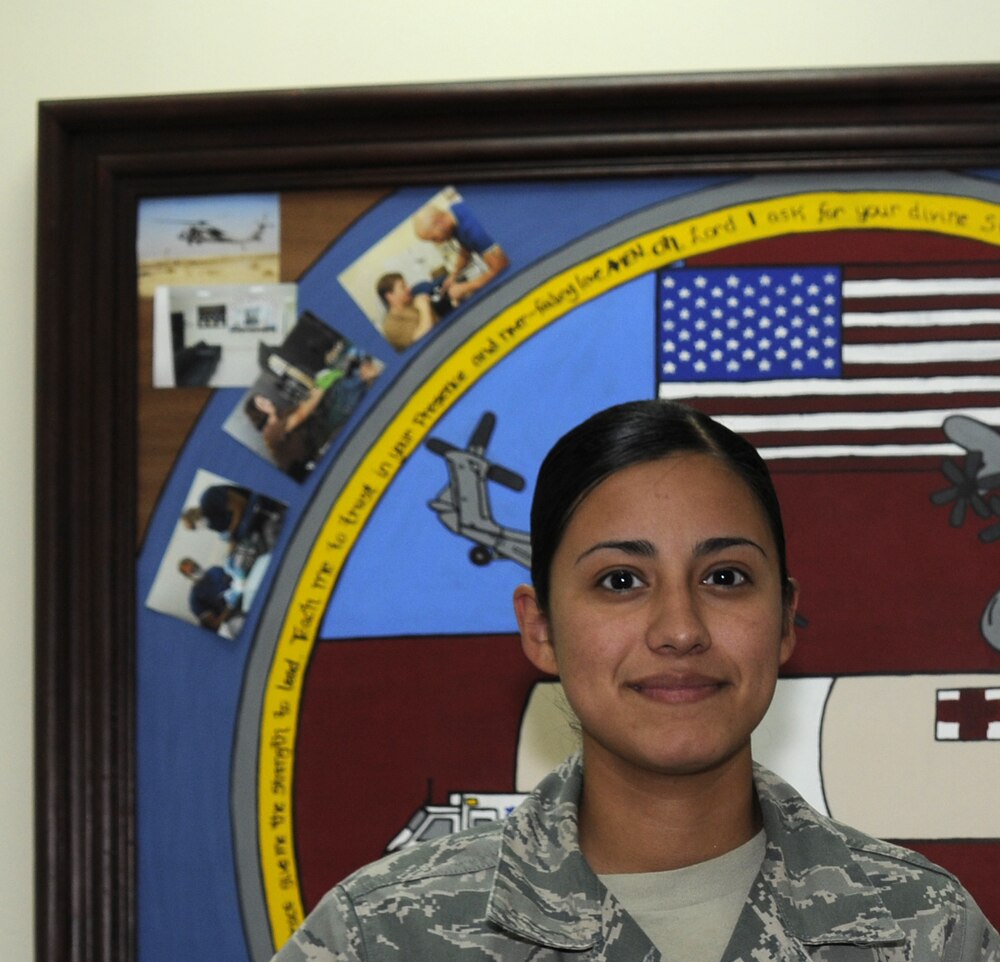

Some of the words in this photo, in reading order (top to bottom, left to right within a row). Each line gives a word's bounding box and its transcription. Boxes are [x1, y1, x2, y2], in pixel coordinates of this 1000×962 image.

[690, 215, 736, 245] Lord
[748, 210, 757, 226] I
[818, 201, 844, 223] for
[854, 203, 899, 223] your
[908, 202, 969, 227] divine
[328, 534, 347, 551] to
[339, 483, 375, 525] trust
[470, 337, 499, 368] and
